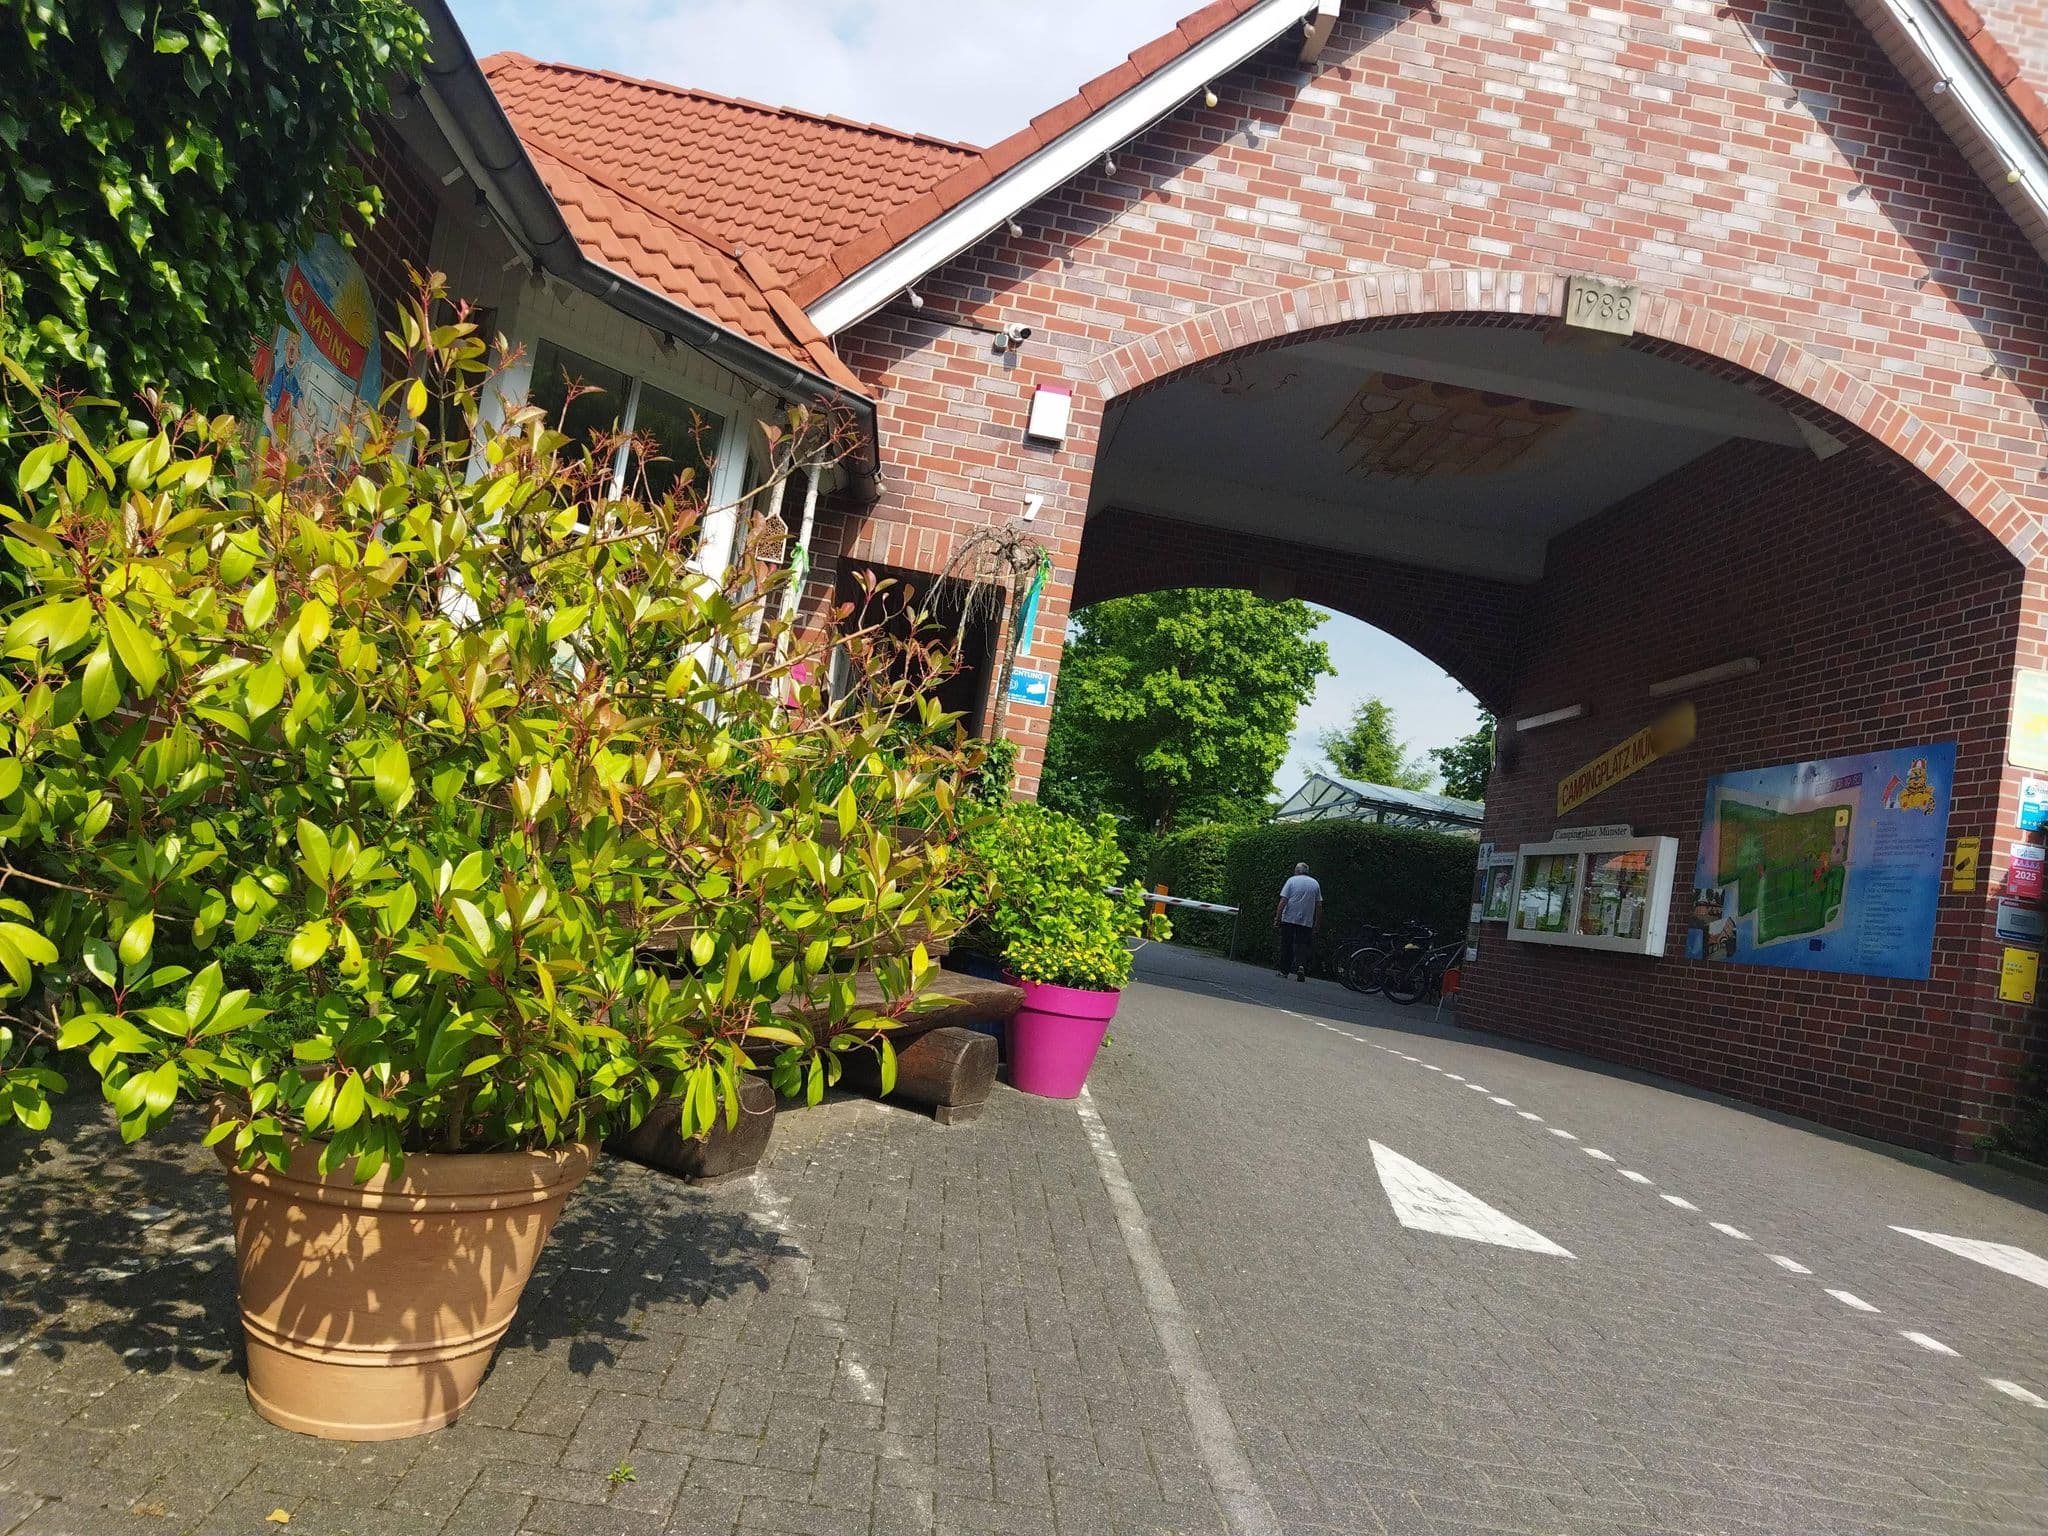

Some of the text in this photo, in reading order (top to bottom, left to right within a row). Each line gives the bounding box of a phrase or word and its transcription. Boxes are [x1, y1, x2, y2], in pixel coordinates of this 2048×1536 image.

[1575, 287, 1632, 321] 1988
[1024, 493, 1044, 520] 7
[1011, 669, 1044, 680] CHTUNG
[1562, 745, 1631, 807] CAMPINGPLATZ
[1599, 825, 1629, 838] Münster
[2015, 870, 2037, 881] 2025
